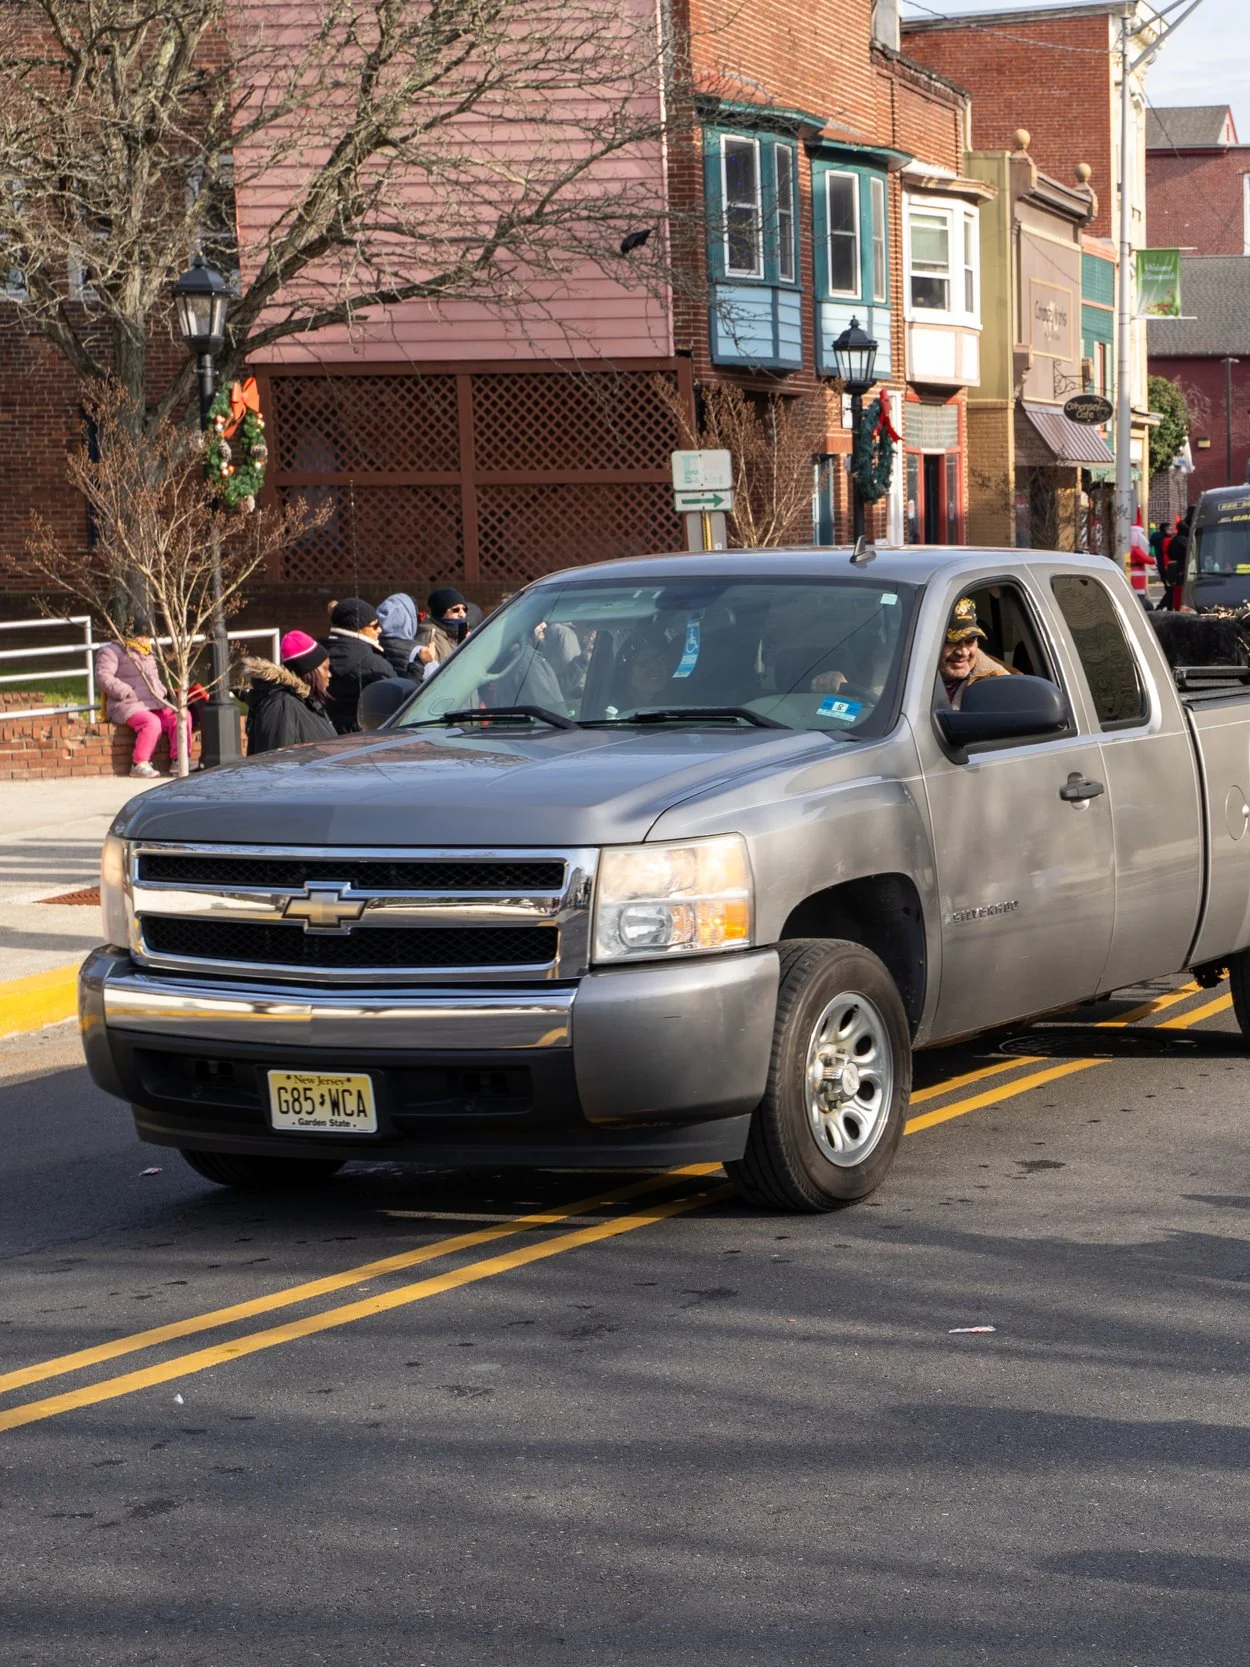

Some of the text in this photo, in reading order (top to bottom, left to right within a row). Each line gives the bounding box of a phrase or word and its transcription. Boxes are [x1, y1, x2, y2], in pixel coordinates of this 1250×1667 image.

[952, 900, 1019, 924] SILVERADO
[293, 1074, 345, 1087] New Jersey
[297, 1117, 351, 1128] Garden State
